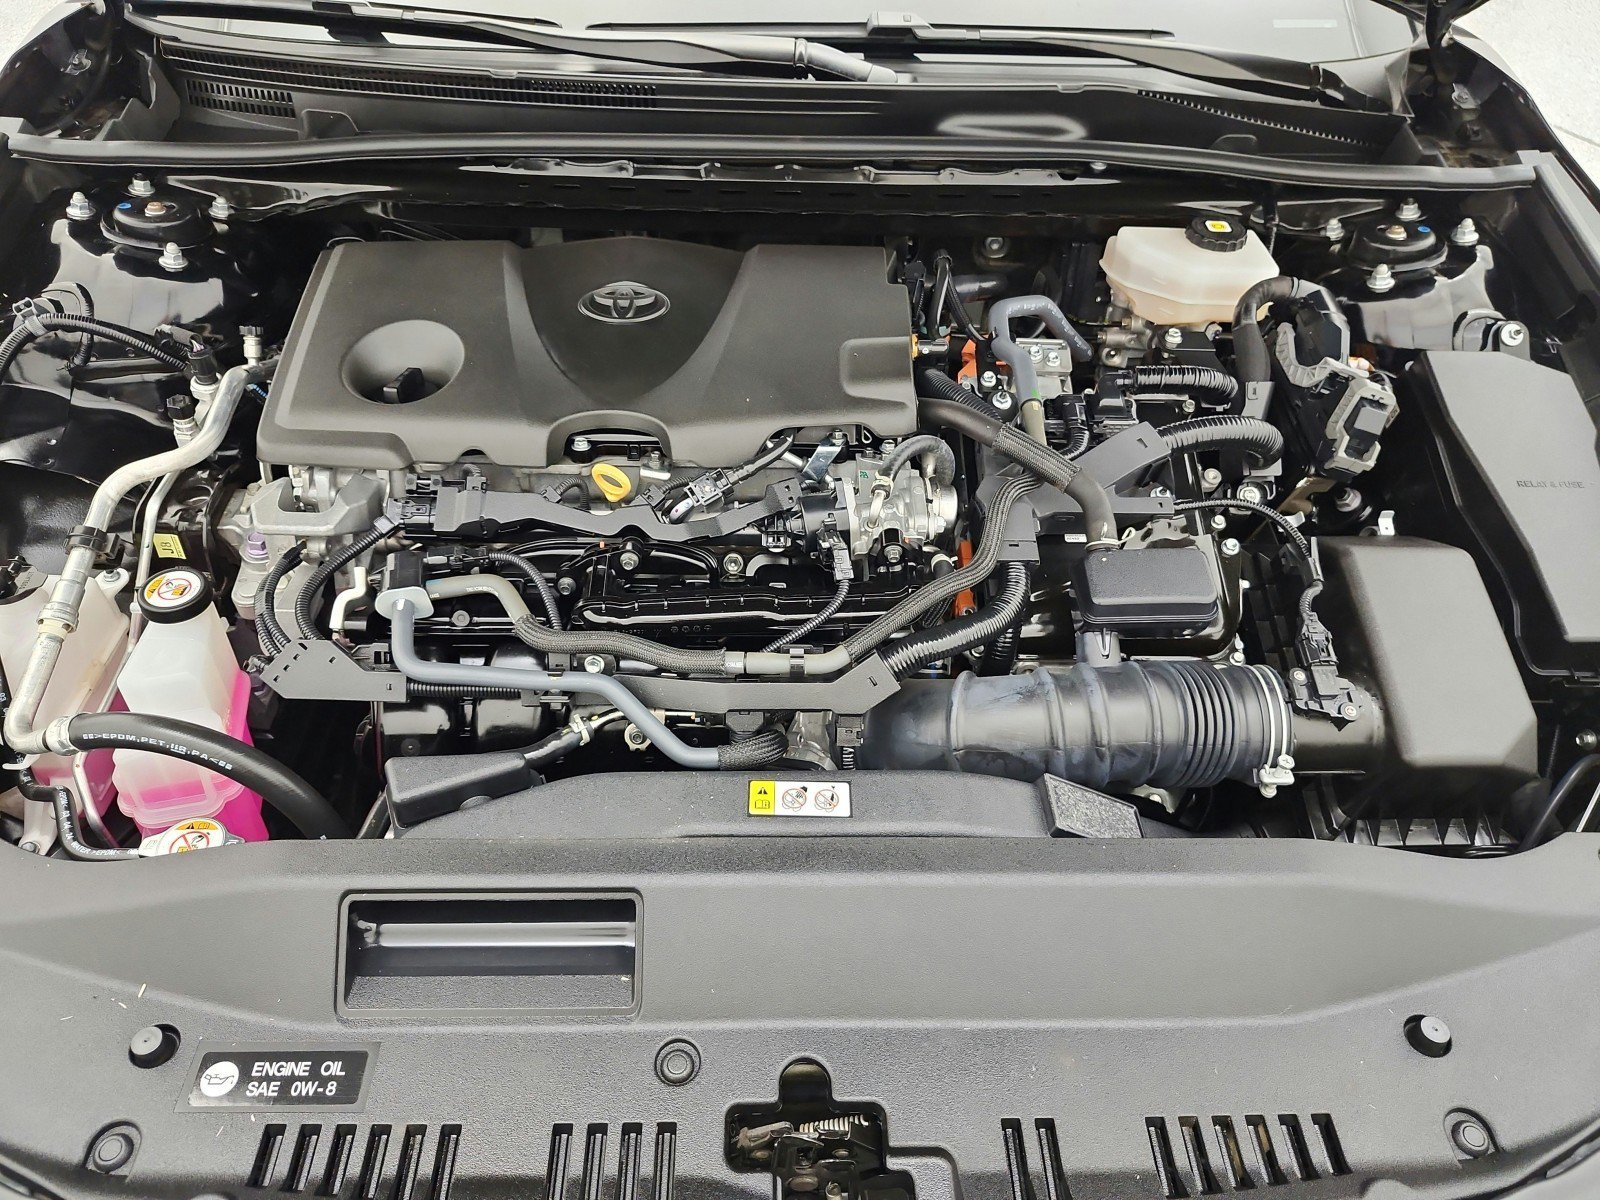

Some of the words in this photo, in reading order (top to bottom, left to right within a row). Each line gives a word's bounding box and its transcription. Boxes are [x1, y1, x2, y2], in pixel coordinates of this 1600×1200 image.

[1516, 480, 1548, 488] RELAY
[1559, 481, 1585, 489] FUSE
[251, 1062, 312, 1077] ENGINE
[320, 1061, 346, 1076] OIL
[245, 1082, 281, 1097] SAE
[291, 1081, 338, 1097] 0W-8
